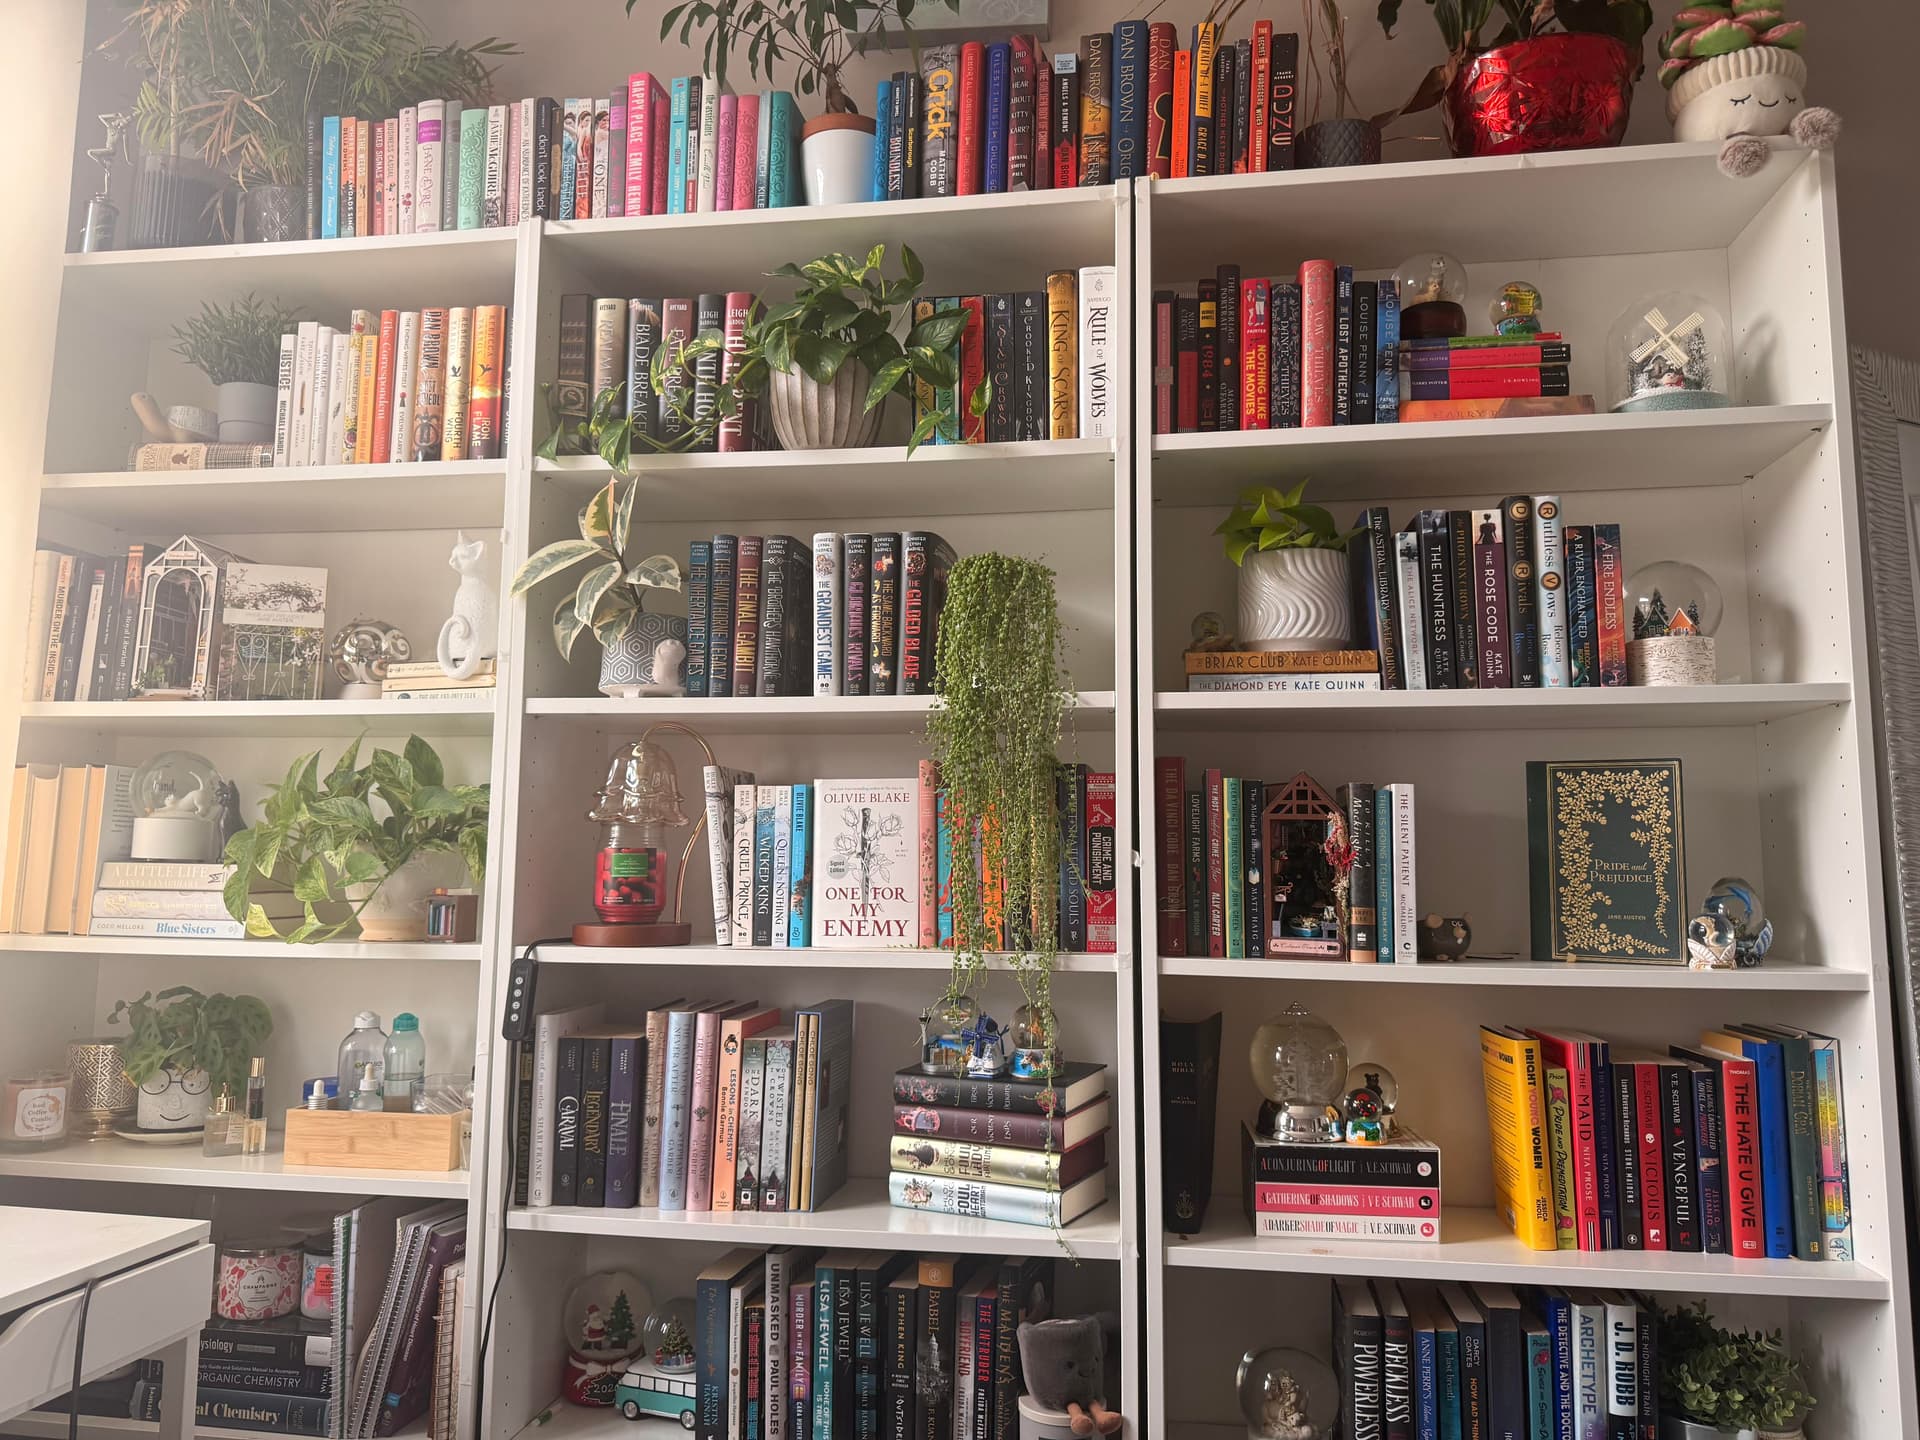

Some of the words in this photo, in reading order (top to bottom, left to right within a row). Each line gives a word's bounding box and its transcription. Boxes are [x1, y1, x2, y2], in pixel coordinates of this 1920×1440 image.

[1015, 50, 1026, 59] DID
[1089, 38, 1102, 69] DAN
[1120, 25, 1135, 60] DAN
[1012, 80, 1029, 89] HEAR
[1013, 65, 1026, 74] YOU
[630, 80, 646, 111] HAPPY
[927, 68, 954, 142] Crick
[1010, 95, 1031, 104] ABOUT
[1087, 71, 1101, 122] BROWN
[1119, 65, 1135, 123] BROWN
[488, 119, 500, 148] JAMIE
[629, 113, 644, 144] PLACE
[1271, 84, 1294, 145] DUNE
[421, 146, 434, 175] JANE
[536, 134, 549, 159] don't
[888, 136, 902, 193] BOUNDLESS
[906, 127, 915, 168] Scarborough
[486, 146, 498, 198] McGUIRE
[536, 161, 547, 184] look
[628, 151, 643, 181] EMILY
[929, 159, 937, 187] COBB
[937, 150, 947, 194] MATTHEW
[536, 187, 547, 212] back
[626, 185, 642, 218] HENRY
[1050, 309, 1070, 353] KING
[1087, 306, 1109, 346] RULE
[1338, 316, 1349, 344] LOST
[1359, 296, 1369, 340] LOUISE
[1384, 293, 1394, 338] LOUISE
[1095, 348, 1104, 359] OF
[1279, 319, 1290, 358] DANCE
[278, 348, 293, 391] JUSTICE
[1057, 354, 1064, 365] OF
[1201, 344, 1214, 379] 1984
[1246, 349, 1256, 372] THE
[1256, 344, 1266, 394] NOTHING
[1358, 344, 1368, 386] PENNY
[1383, 342, 1393, 384] PENNY
[1050, 367, 1070, 421] SCARS
[1087, 362, 1112, 418] WOLVES
[1245, 372, 1256, 416] MOVIES
[1279, 365, 1290, 416] THIEVES
[1336, 347, 1349, 416] APOTHECARY
[1257, 396, 1267, 420] LIKE
[445, 417, 454, 443] WING
[453, 411, 464, 449] FOURTH
[471, 411, 482, 447] FLAME
[480, 417, 491, 440] IRON
[1510, 501, 1532, 557] Divine
[1537, 501, 1559, 568] Ruthless
[690, 561, 708, 579] THE
[712, 556, 731, 576] THE
[738, 566, 759, 588] THE
[1573, 543, 1584, 574] RIVER
[1602, 553, 1615, 579] FIRE
[53, 585, 67, 620] MURDER
[1484, 568, 1497, 604] ROSE
[1511, 559, 1534, 615] Rivals
[1540, 571, 1562, 618] Vows
[1603, 580, 1617, 630] ENDLESS
[688, 581, 707, 640] INHERITANCE
[711, 578, 731, 639] HAWTHORNE
[737, 592, 758, 627] FINAL
[816, 590, 833, 649] GRANDEST
[903, 588, 923, 635] GILDED
[1431, 573, 1446, 642] HUNTRESS
[1485, 605, 1498, 643] CODE
[1575, 574, 1589, 638] ENCHANTED
[50, 633, 61, 649] THE
[52, 620, 61, 634] ON
[46, 649, 58, 677] INSIDE
[687, 641, 704, 676] GAMES
[710, 641, 730, 680] LEGACY
[735, 630, 756, 674] GAMBIT
[817, 650, 833, 680] GAME
[903, 637, 921, 680] BLADE
[1204, 655, 1244, 669] BRIAR
[1247, 655, 1285, 669] CLUB
[1292, 654, 1319, 667] KATE
[1322, 654, 1362, 666] QUINN
[1485, 649, 1495, 679] QUINN
[1493, 652, 1503, 675] KATE
[1214, 681, 1264, 691] DIAMOND
[1268, 680, 1287, 691] EYE
[1294, 680, 1321, 691] KATE
[1325, 680, 1365, 690] QUINN
[823, 793, 866, 804] OLIVIE
[869, 792, 911, 803] BLAKE
[1400, 813, 1410, 846] SILENT
[739, 838, 751, 877] CRUEL
[758, 836, 772, 882] WICKED
[775, 838, 788, 876] QUEEN
[1092, 832, 1102, 886] PUNISHMENT
[1101, 836, 1112, 862] CRIME
[1400, 848, 1410, 887] PATIENT
[1594, 858, 1630, 872] PRIDE
[1630, 862, 1648, 871] and
[1102, 863, 1112, 881] AND
[1589, 870, 1653, 884] PREJUDICE
[735, 880, 751, 921] PRINCE
[755, 884, 771, 915] KING
[775, 881, 786, 925] NOTHING
[825, 886, 861, 901] ONE
[870, 886, 914, 904] FOR
[849, 902, 885, 917] MY
[155, 922, 180, 934] Blue
[180, 922, 217, 935] Sisters
[823, 919, 911, 937] ENEMY
[1524, 1048, 1537, 1086] BRIGHT
[727, 1069, 738, 1105] LESSONS
[749, 1075, 761, 1119] DARK
[774, 1073, 786, 1128] TWISTED
[1734, 1083, 1750, 1115] THE
[558, 1095, 580, 1151] CARAVAL
[583, 1090, 605, 1154] LEGENDARY
[727, 1107, 735, 1115] in
[1528, 1088, 1540, 1126] YOUNG
[1553, 1106, 1564, 1135] PRIDE
[1577, 1094, 1592, 1141] MAID
[609, 1099, 632, 1156] FINALE
[725, 1115, 735, 1163] CHEMISTRY
[1736, 1121, 1752, 1165] HATE
[1530, 1126, 1543, 1169] WOMEN
[1554, 1150, 1569, 1212] PREMEDITATION
[1583, 1171, 1594, 1201] PROSE
[1645, 1148, 1661, 1221] VICIOUS
[1672, 1139, 1690, 1225] VENGEFUL
[1738, 1169, 1753, 1182] U
[1741, 1186, 1756, 1228] GIVE
[242, 1282, 278, 1291] CHAMPAGNE
[770, 1263, 780, 1341] UNMASKED
[819, 1280, 830, 1313] LISA
[898, 1293, 906, 1339] STEPHEN
[928, 1290, 941, 1335] BABEL
[1614, 1321, 1635, 1336] J.
[818, 1316, 830, 1371] JEWELL
[897, 1342, 905, 1369] KING
[977, 1328, 992, 1382] INTRUDER
[1557, 1325, 1569, 1369] DETECTIVE
[1614, 1341, 1636, 1357] D.
[244, 1374, 302, 1388] CHEMISTRY
[769, 1359, 779, 1391] PAUL
[1384, 1341, 1410, 1423] RECKLESS
[1580, 1314, 1597, 1415] ARCHETYPE
[1615, 1360, 1636, 1407] ROBB
[212, 1401, 280, 1425] Chemistry
[769, 1394, 779, 1435] HOLES
